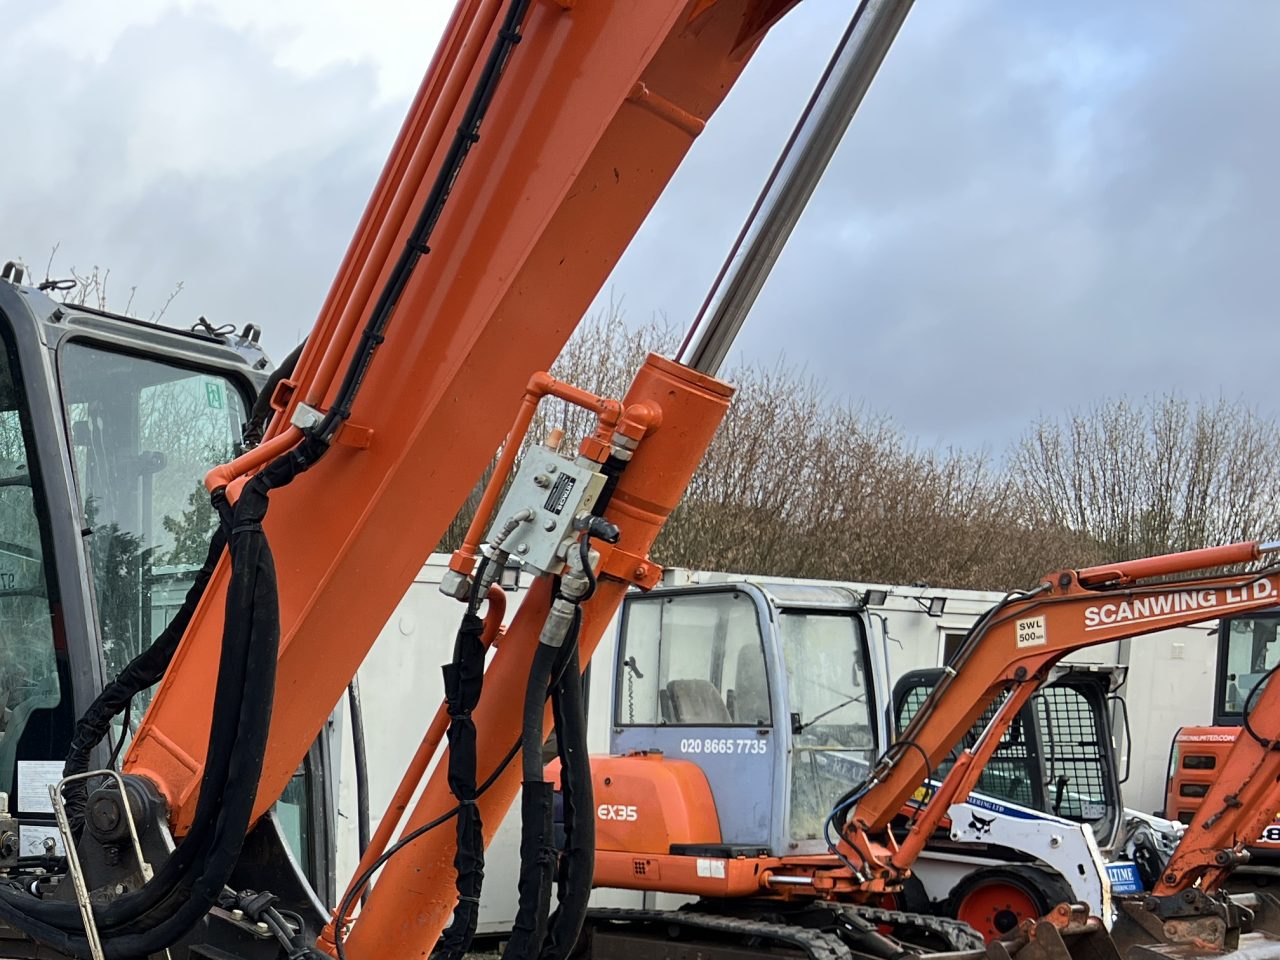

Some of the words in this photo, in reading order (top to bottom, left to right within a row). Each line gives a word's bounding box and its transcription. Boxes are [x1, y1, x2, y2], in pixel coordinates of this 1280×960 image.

[557, 482, 574, 510] HITACHI
[1084, 589, 1217, 626] SCANWING
[1019, 620, 1042, 631] SWL
[1019, 632, 1036, 642] 500
[680, 738, 702, 753] 020
[704, 738, 734, 754] 8665
[736, 739, 767, 754] 7735
[597, 804, 638, 821] EX35
